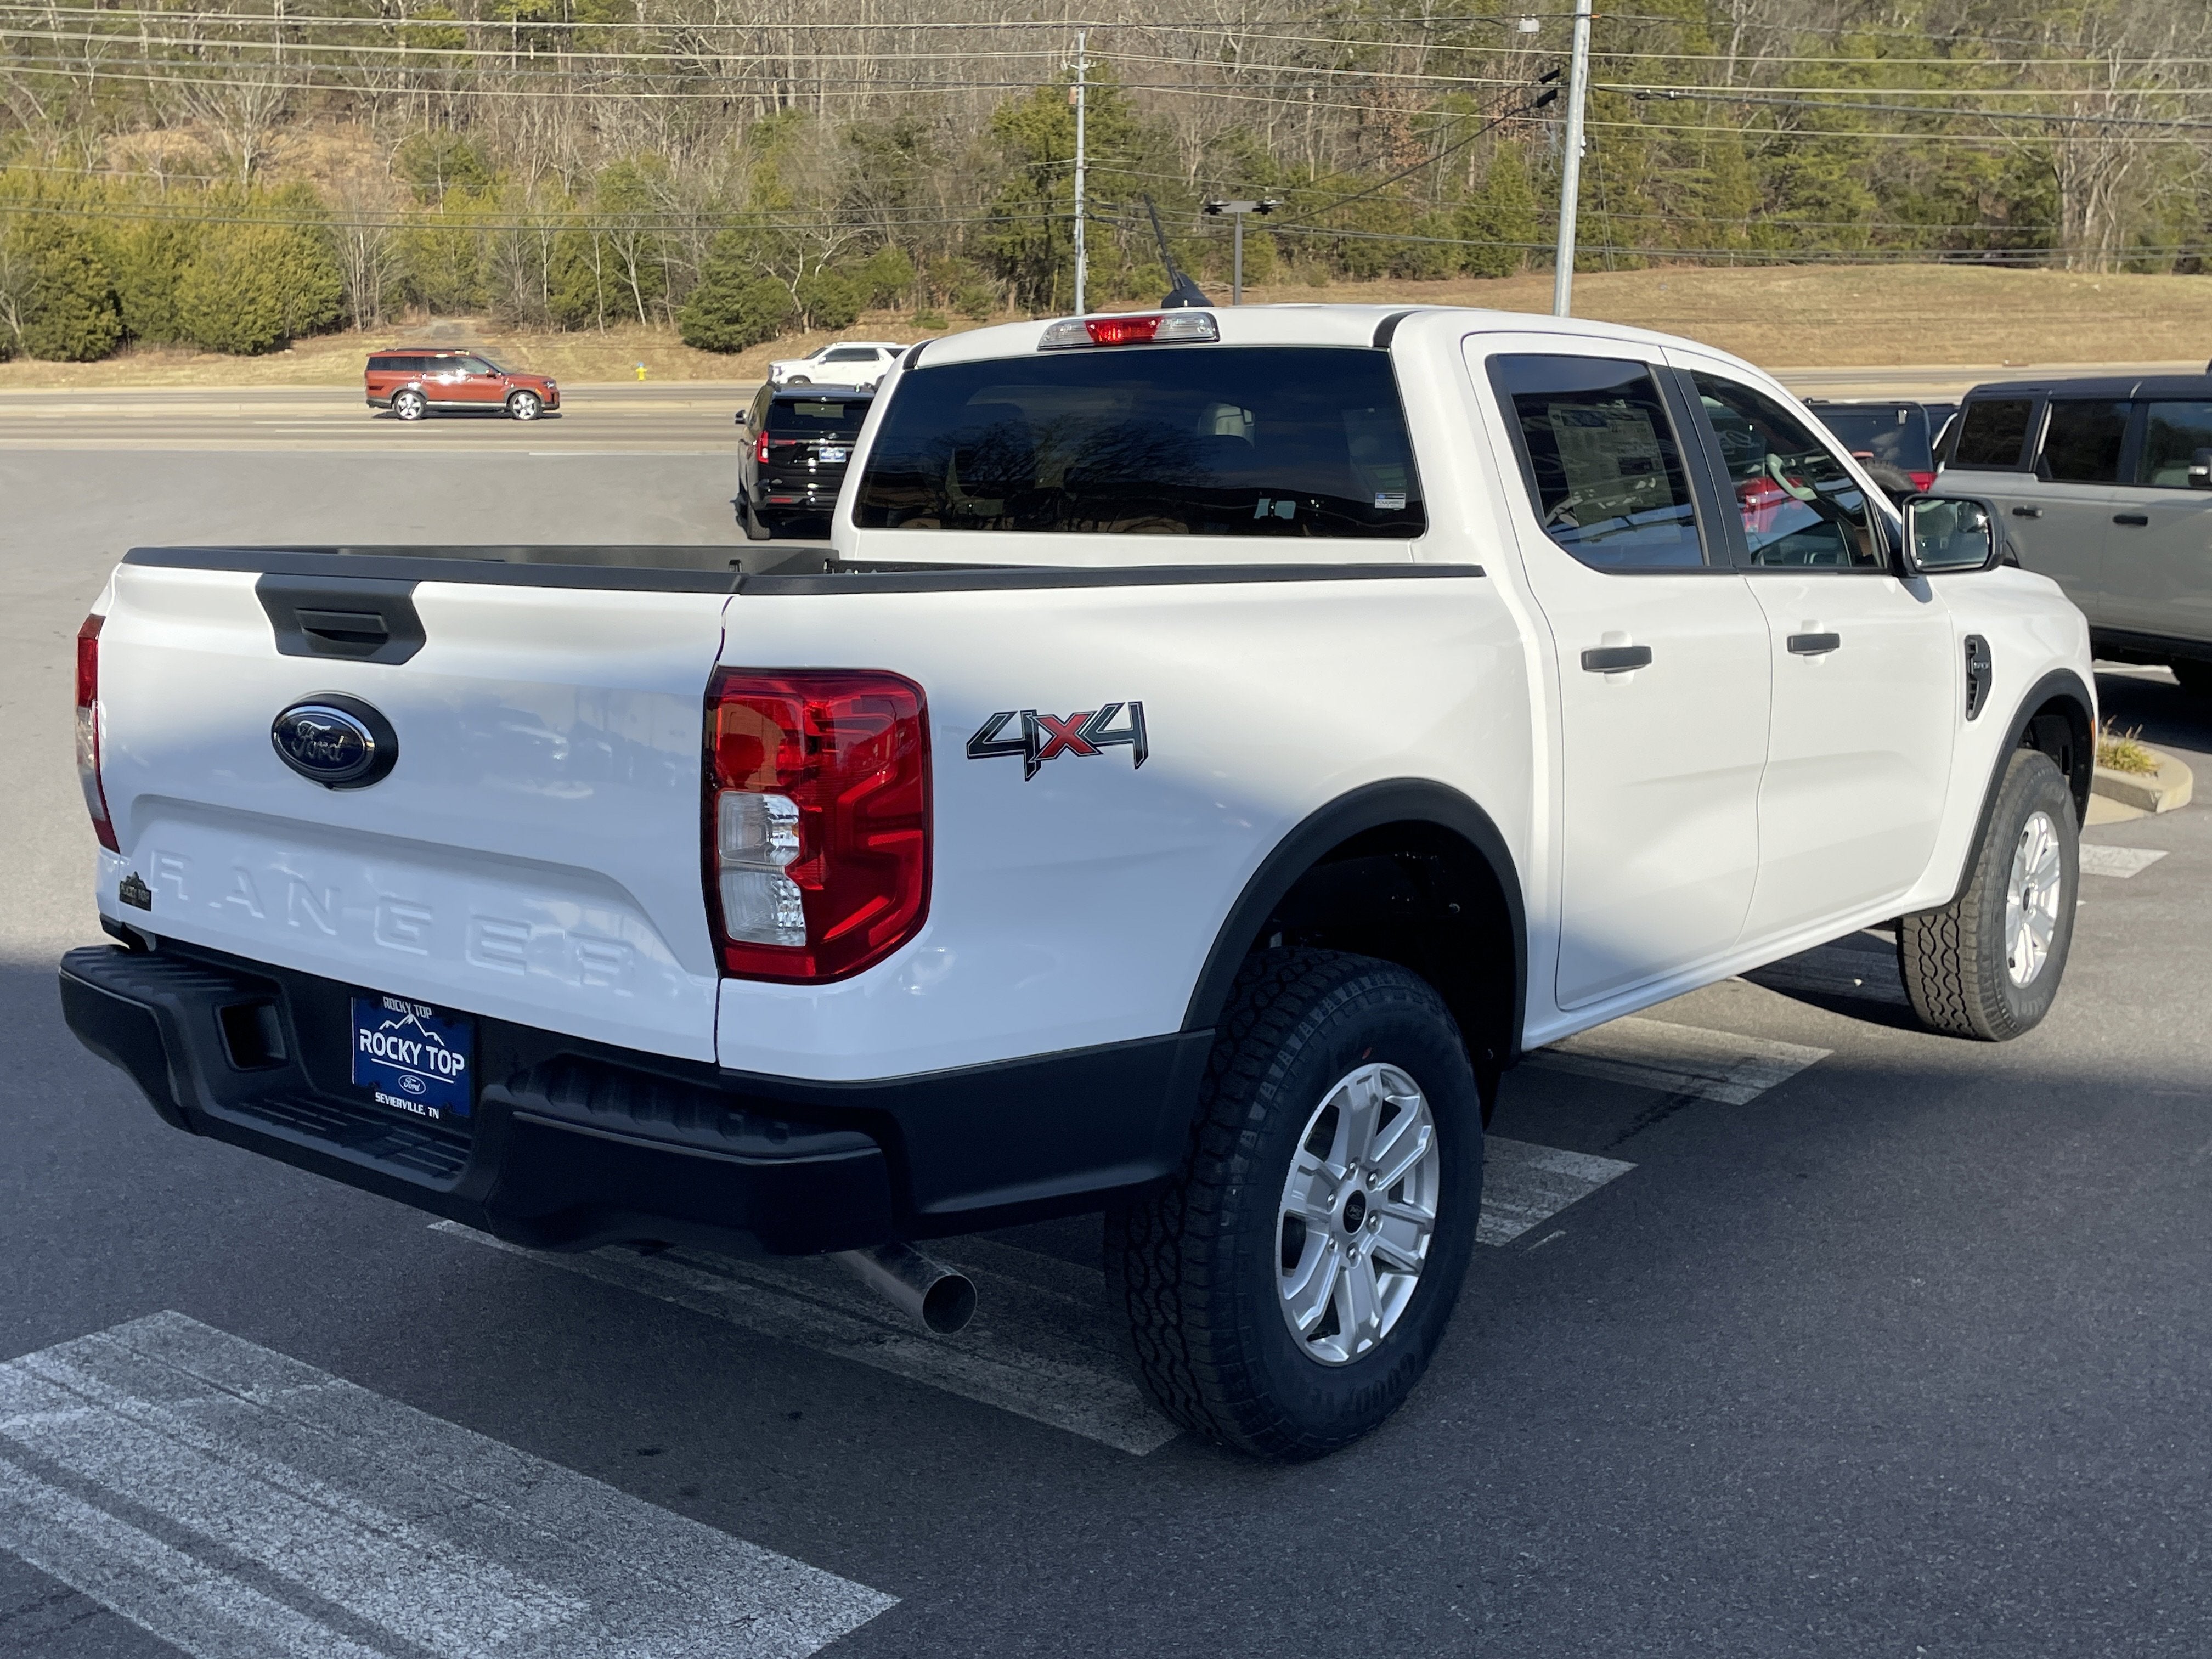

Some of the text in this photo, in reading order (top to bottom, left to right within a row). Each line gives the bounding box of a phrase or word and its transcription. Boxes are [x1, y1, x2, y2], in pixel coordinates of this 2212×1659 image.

[291, 720, 345, 761] Ford
[149, 849, 636, 998] RANGER
[383, 996, 432, 1019] ROCKY TOP
[360, 1028, 465, 1076] ROCKY TOP
[403, 1076, 422, 1092] Ford
[428, 1107, 439, 1119] TN
